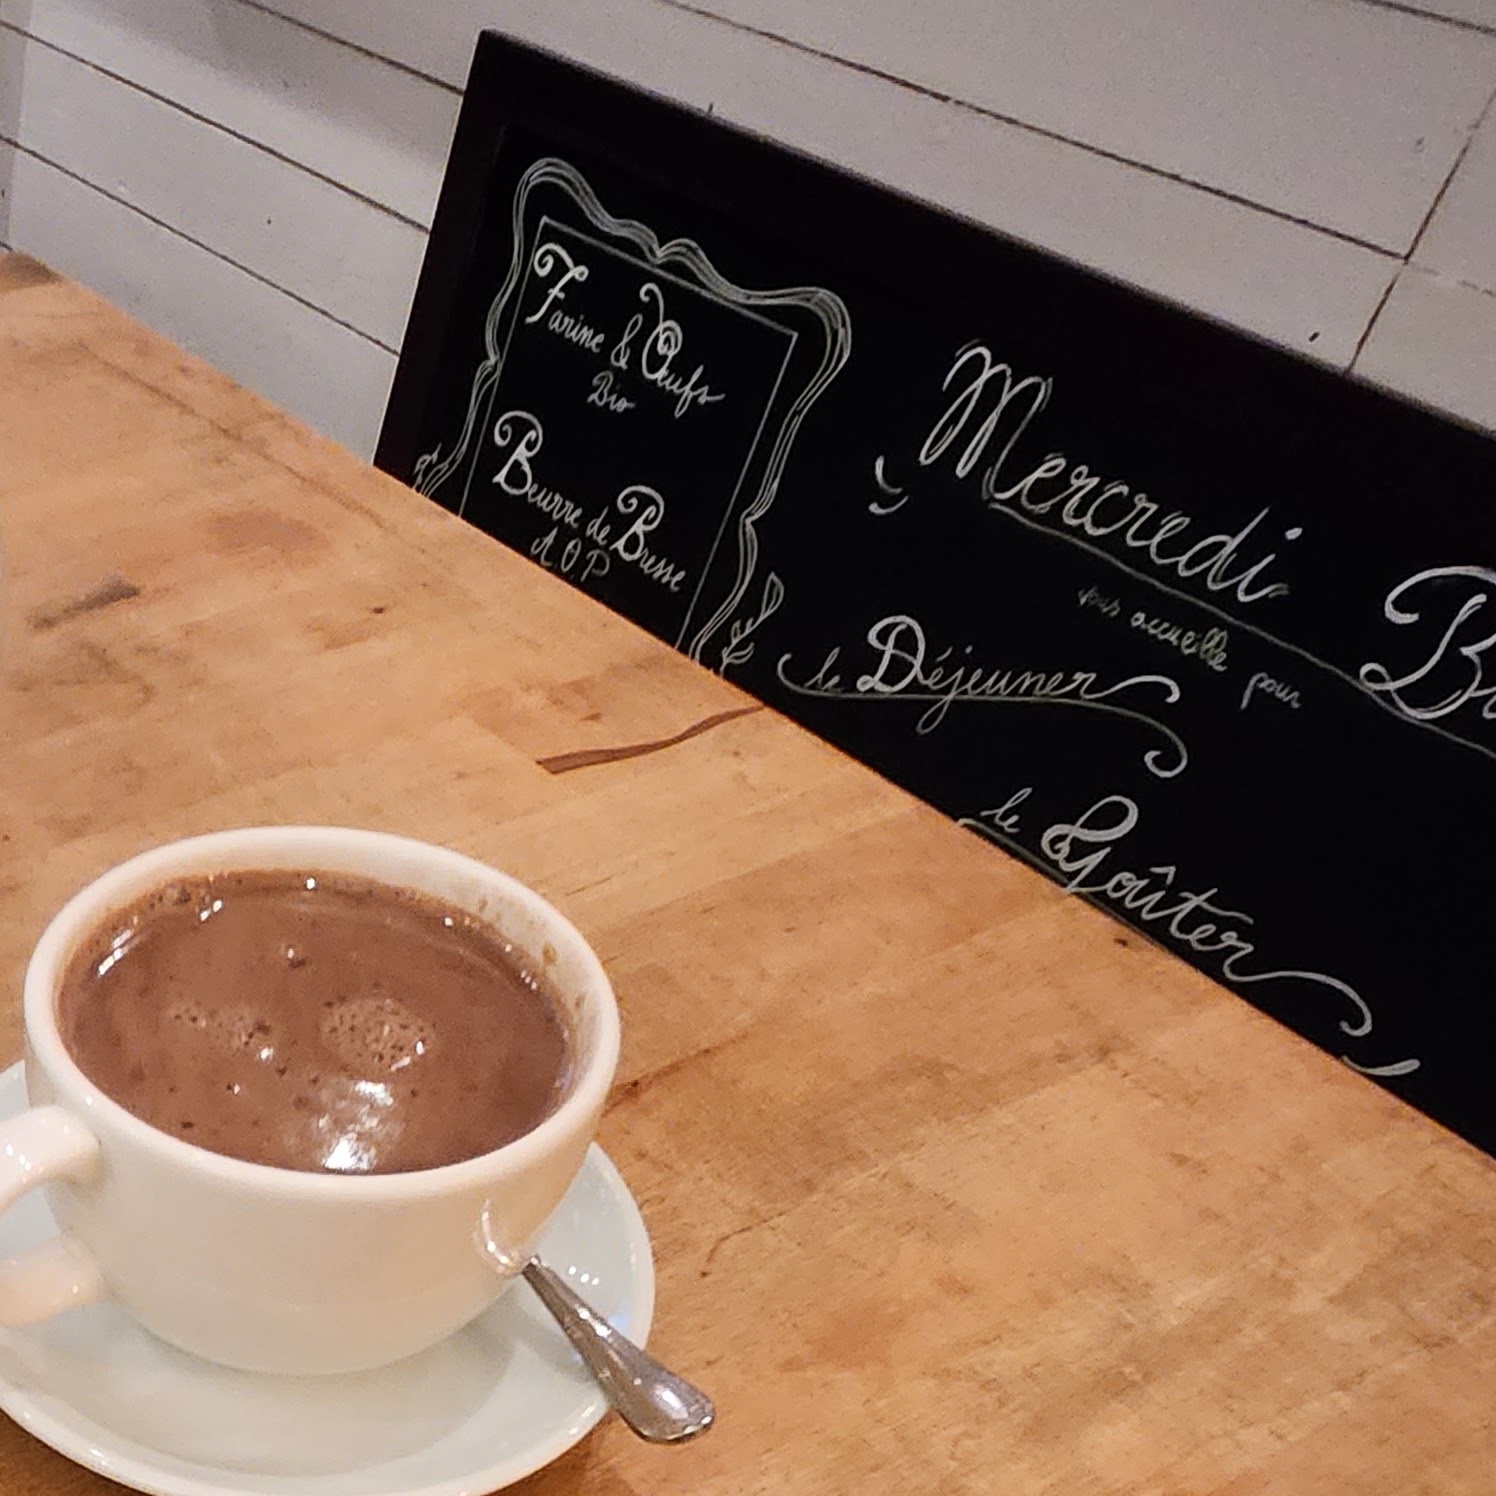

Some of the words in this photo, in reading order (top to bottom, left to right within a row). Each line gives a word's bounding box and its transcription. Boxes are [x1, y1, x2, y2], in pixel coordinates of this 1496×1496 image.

[525, 243, 604, 352] Farine
[610, 313, 643, 369] &
[587, 370, 635, 412] Bio
[493, 411, 580, 528] Beurre
[585, 507, 611, 545] de
[610, 485, 685, 593] Bresse
[919, 340, 1303, 602] Mercredi
[1360, 566, 1496, 719] B
[806, 646, 840, 692] le
[857, 614, 1180, 735] Déjeuner
[1130, 610, 1227, 671] accueille
[1240, 672, 1302, 709] pour
[981, 788, 1032, 833] le
